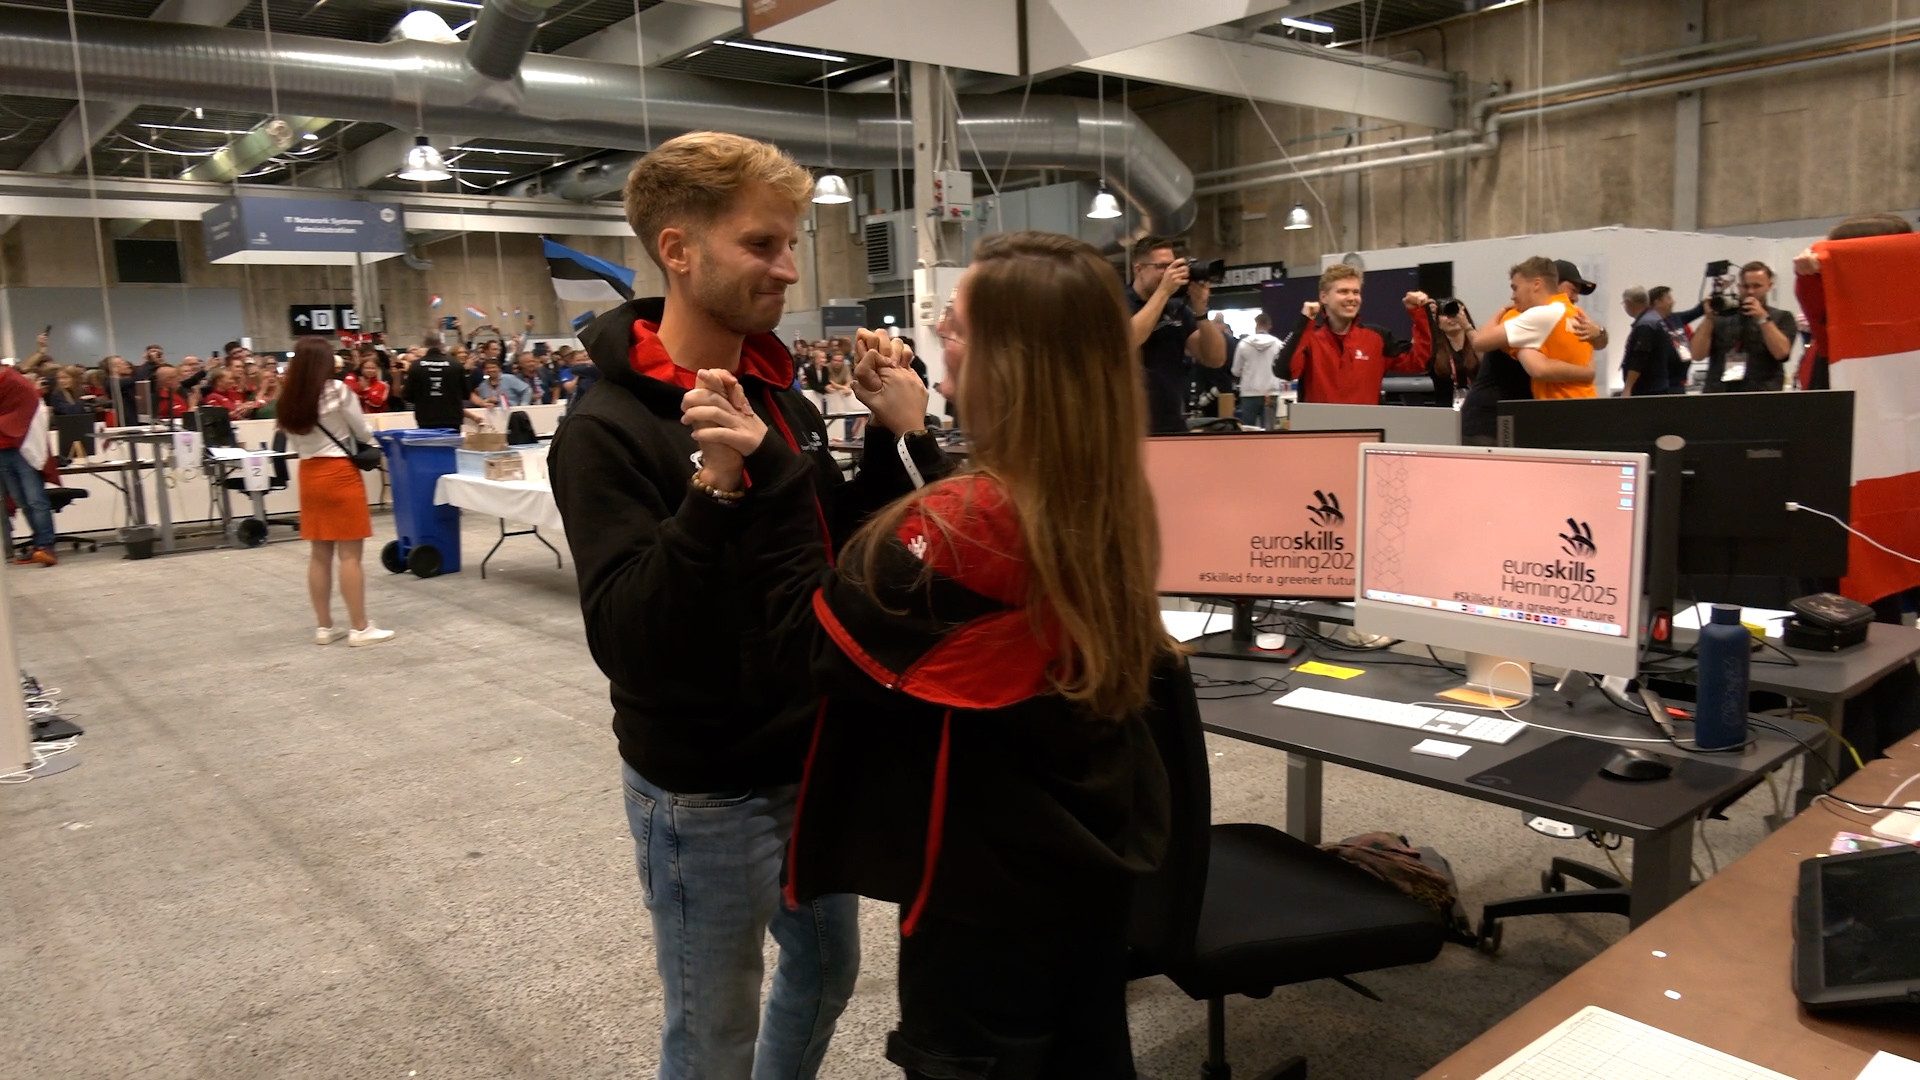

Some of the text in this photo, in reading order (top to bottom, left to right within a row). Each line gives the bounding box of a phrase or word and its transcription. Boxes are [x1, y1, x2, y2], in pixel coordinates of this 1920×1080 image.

[294, 226, 357, 234] Administration
[251, 467, 262, 477] 2
[1250, 531, 1344, 550] euroskills
[1250, 551, 1355, 574] Herning202
[1502, 559, 1596, 583] euroskills
[1199, 572, 1242, 583] #Skilled
[1246, 572, 1262, 583] for
[1277, 575, 1323, 587] greener
[1327, 573, 1356, 586] futur
[1501, 575, 1618, 606] Herning2025
[1452, 591, 1616, 623] #Skilled for a greener future
